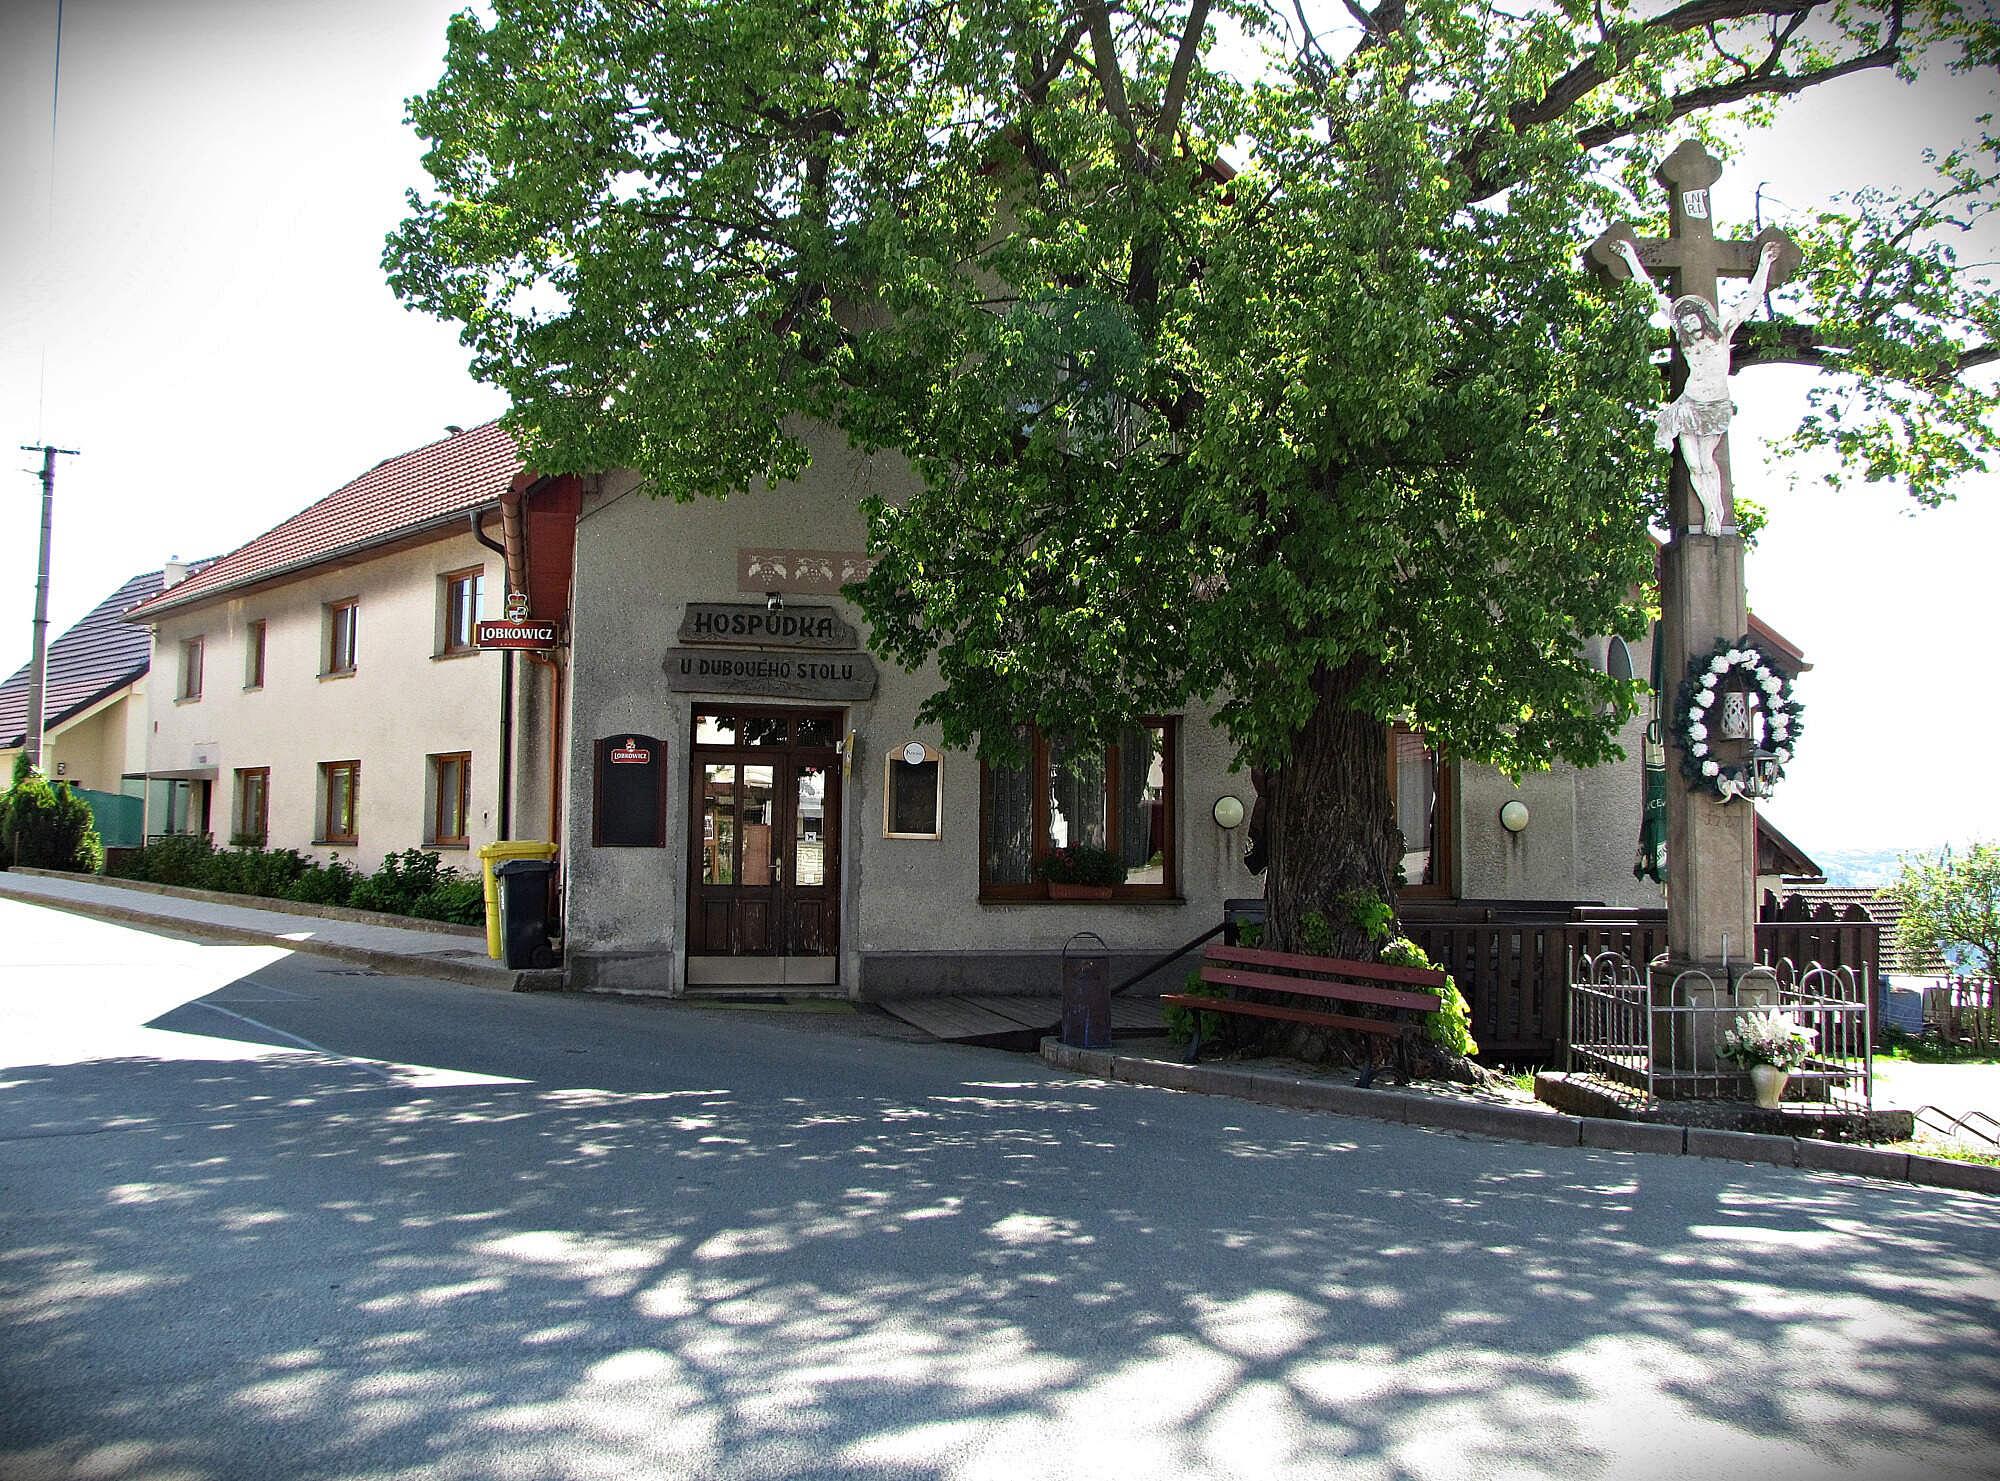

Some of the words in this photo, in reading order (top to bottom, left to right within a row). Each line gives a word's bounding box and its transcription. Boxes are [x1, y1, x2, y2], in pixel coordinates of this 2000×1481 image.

[481, 627, 553, 641] LOBKOWICZ
[680, 658, 692, 675] U
[797, 663, 853, 680] STOLU
[614, 752, 647, 760] LOBKOWICZ
